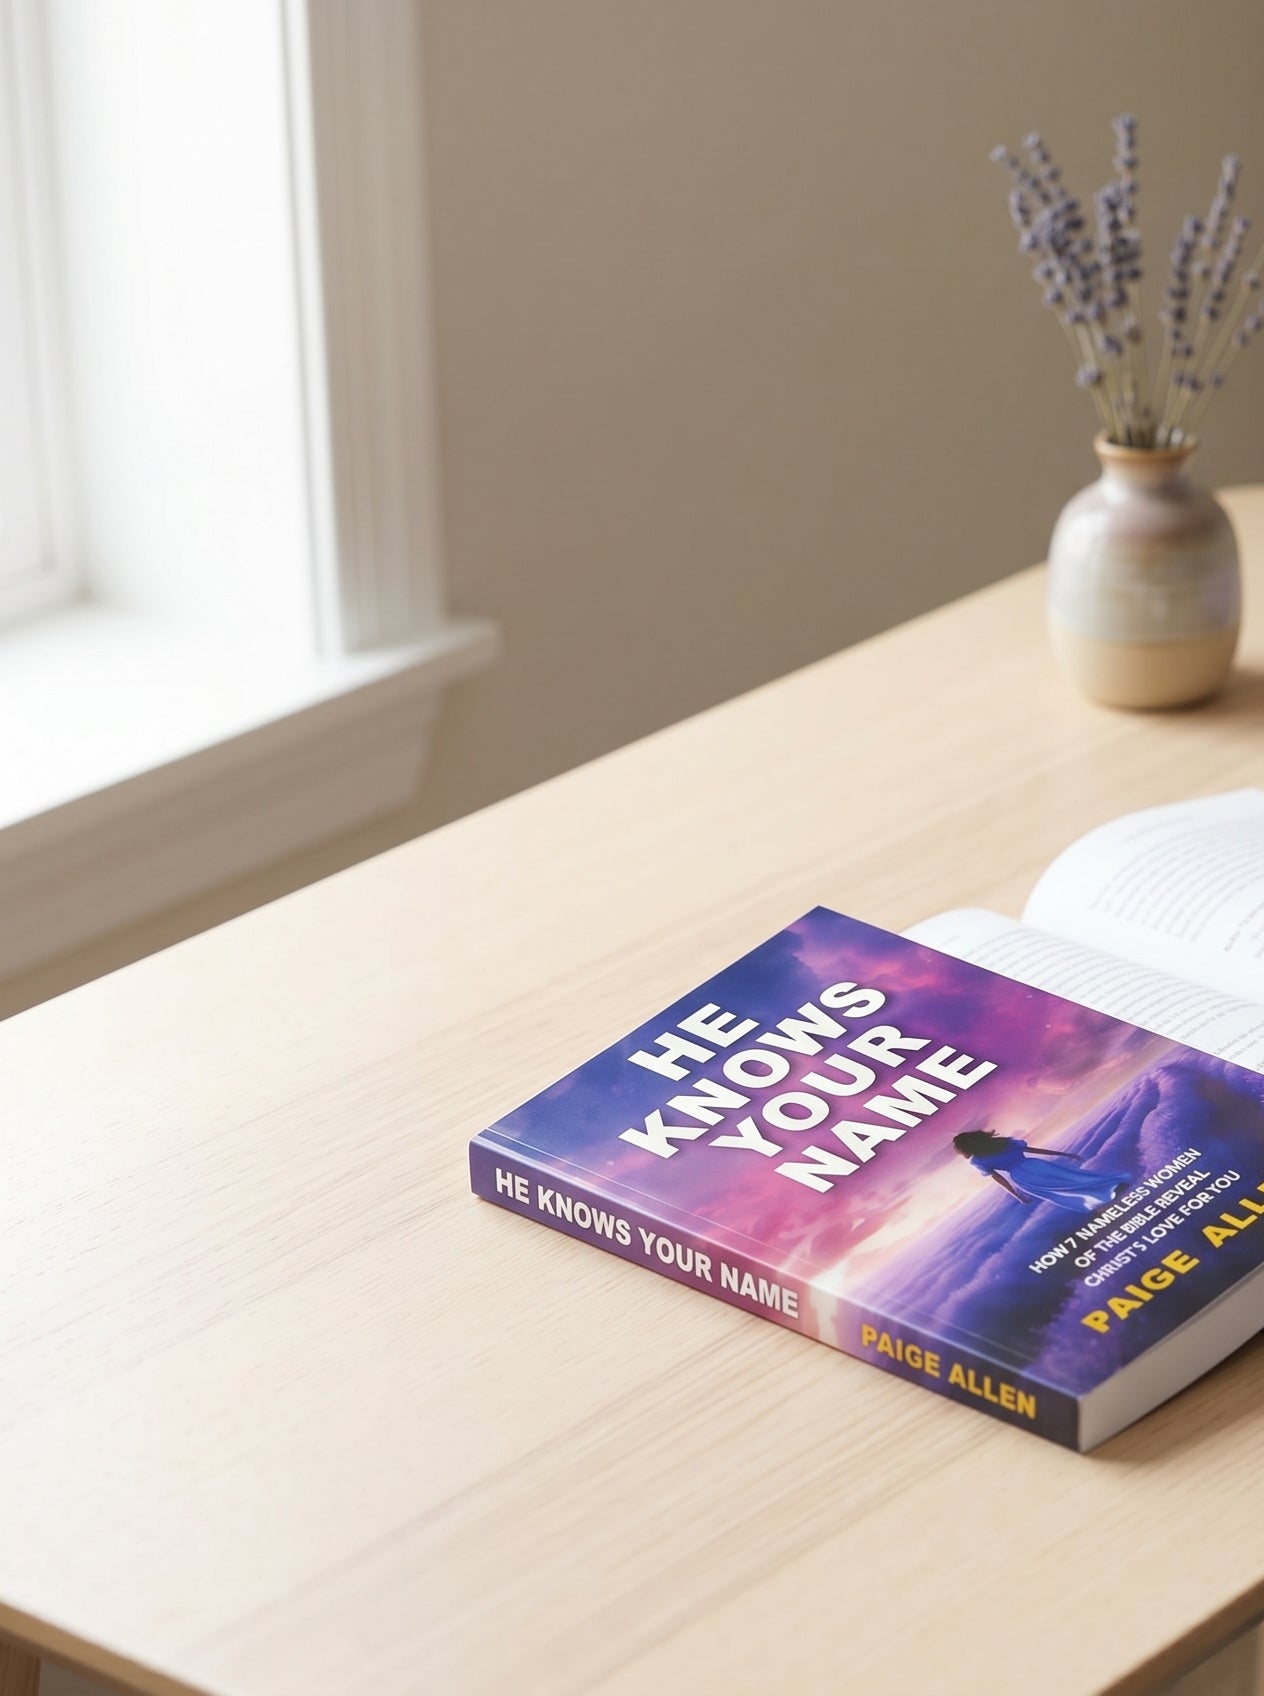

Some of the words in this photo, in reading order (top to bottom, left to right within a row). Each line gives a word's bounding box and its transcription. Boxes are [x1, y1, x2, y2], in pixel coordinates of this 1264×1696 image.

[618, 981, 886, 1159] KNOWS
[626, 1002, 760, 1081] HE
[708, 1025, 932, 1158] YOUR
[773, 1045, 999, 1193] NAME
[495, 1168, 530, 1205] HE
[537, 1184, 632, 1246] KNOWS
[638, 1226, 713, 1283] YOUR
[720, 1261, 799, 1319] NAME
[1029, 1241, 1069, 1274] HOW
[1064, 1238, 1078, 1249] 7
[1075, 1186, 1151, 1241] NAMELESS
[1143, 1147, 1202, 1189] WOMEN
[1074, 1249, 1098, 1268] OF
[1093, 1230, 1127, 1252] THE
[1121, 1205, 1161, 1234] BIBLE
[1154, 1168, 1211, 1209] REVEAL
[1084, 1241, 1147, 1288] CHRIST'S
[1142, 1213, 1185, 1245] LOVE
[1178, 1192, 1214, 1216] FOR
[1205, 1170, 1241, 1195] YOU
[1081, 1249, 1200, 1334] PAIGE
[861, 1323, 940, 1378] PAIGE
[948, 1363, 1036, 1419] ALLEN
